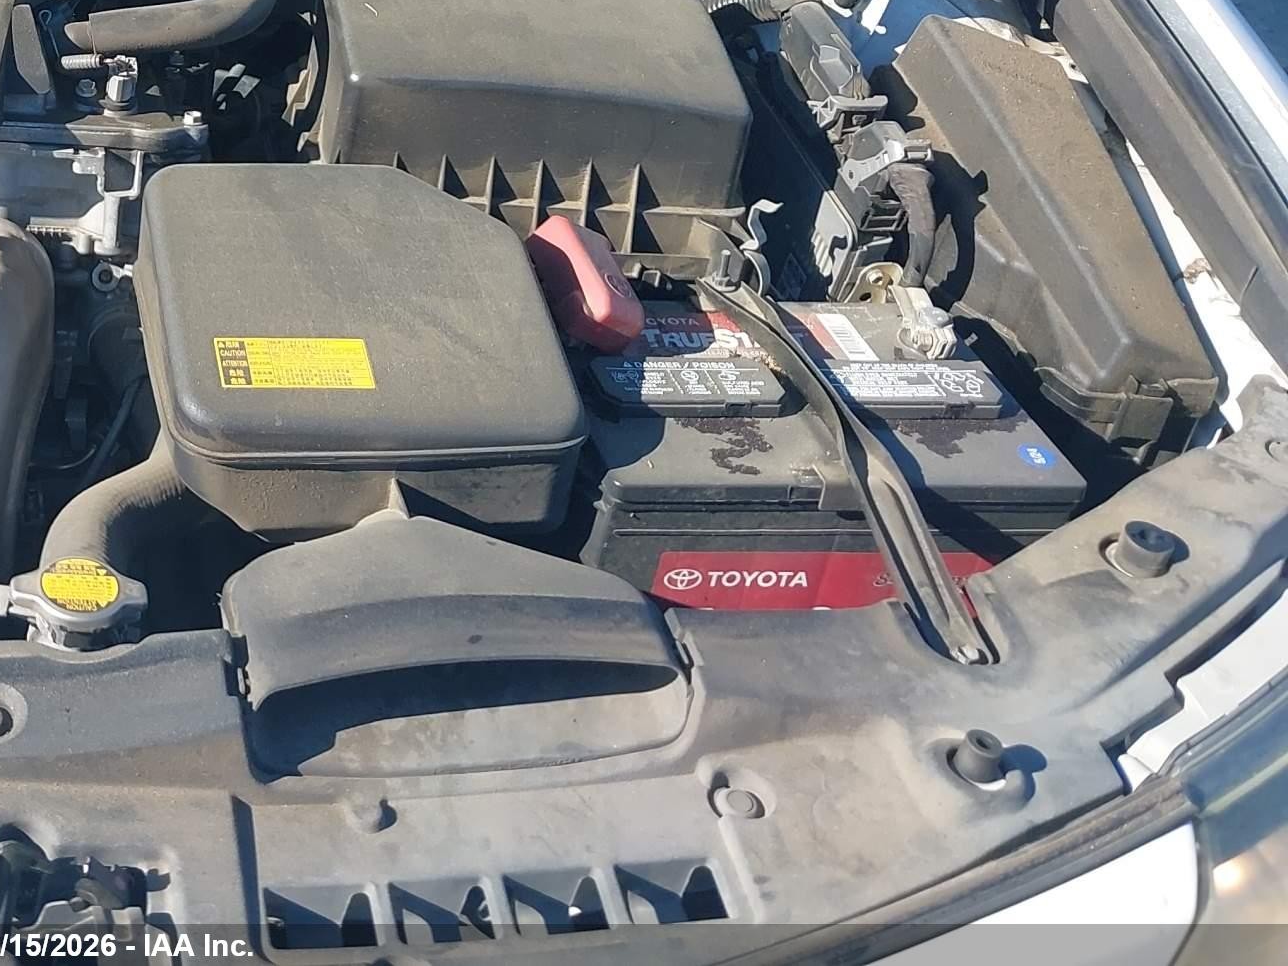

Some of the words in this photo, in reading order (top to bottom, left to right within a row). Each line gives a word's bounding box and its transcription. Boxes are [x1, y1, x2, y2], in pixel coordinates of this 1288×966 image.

[220, 349, 246, 357] CAUTION
[634, 361, 683, 369] DANGER
[694, 362, 735, 370] POISON
[707, 570, 808, 588] TOYOTA
